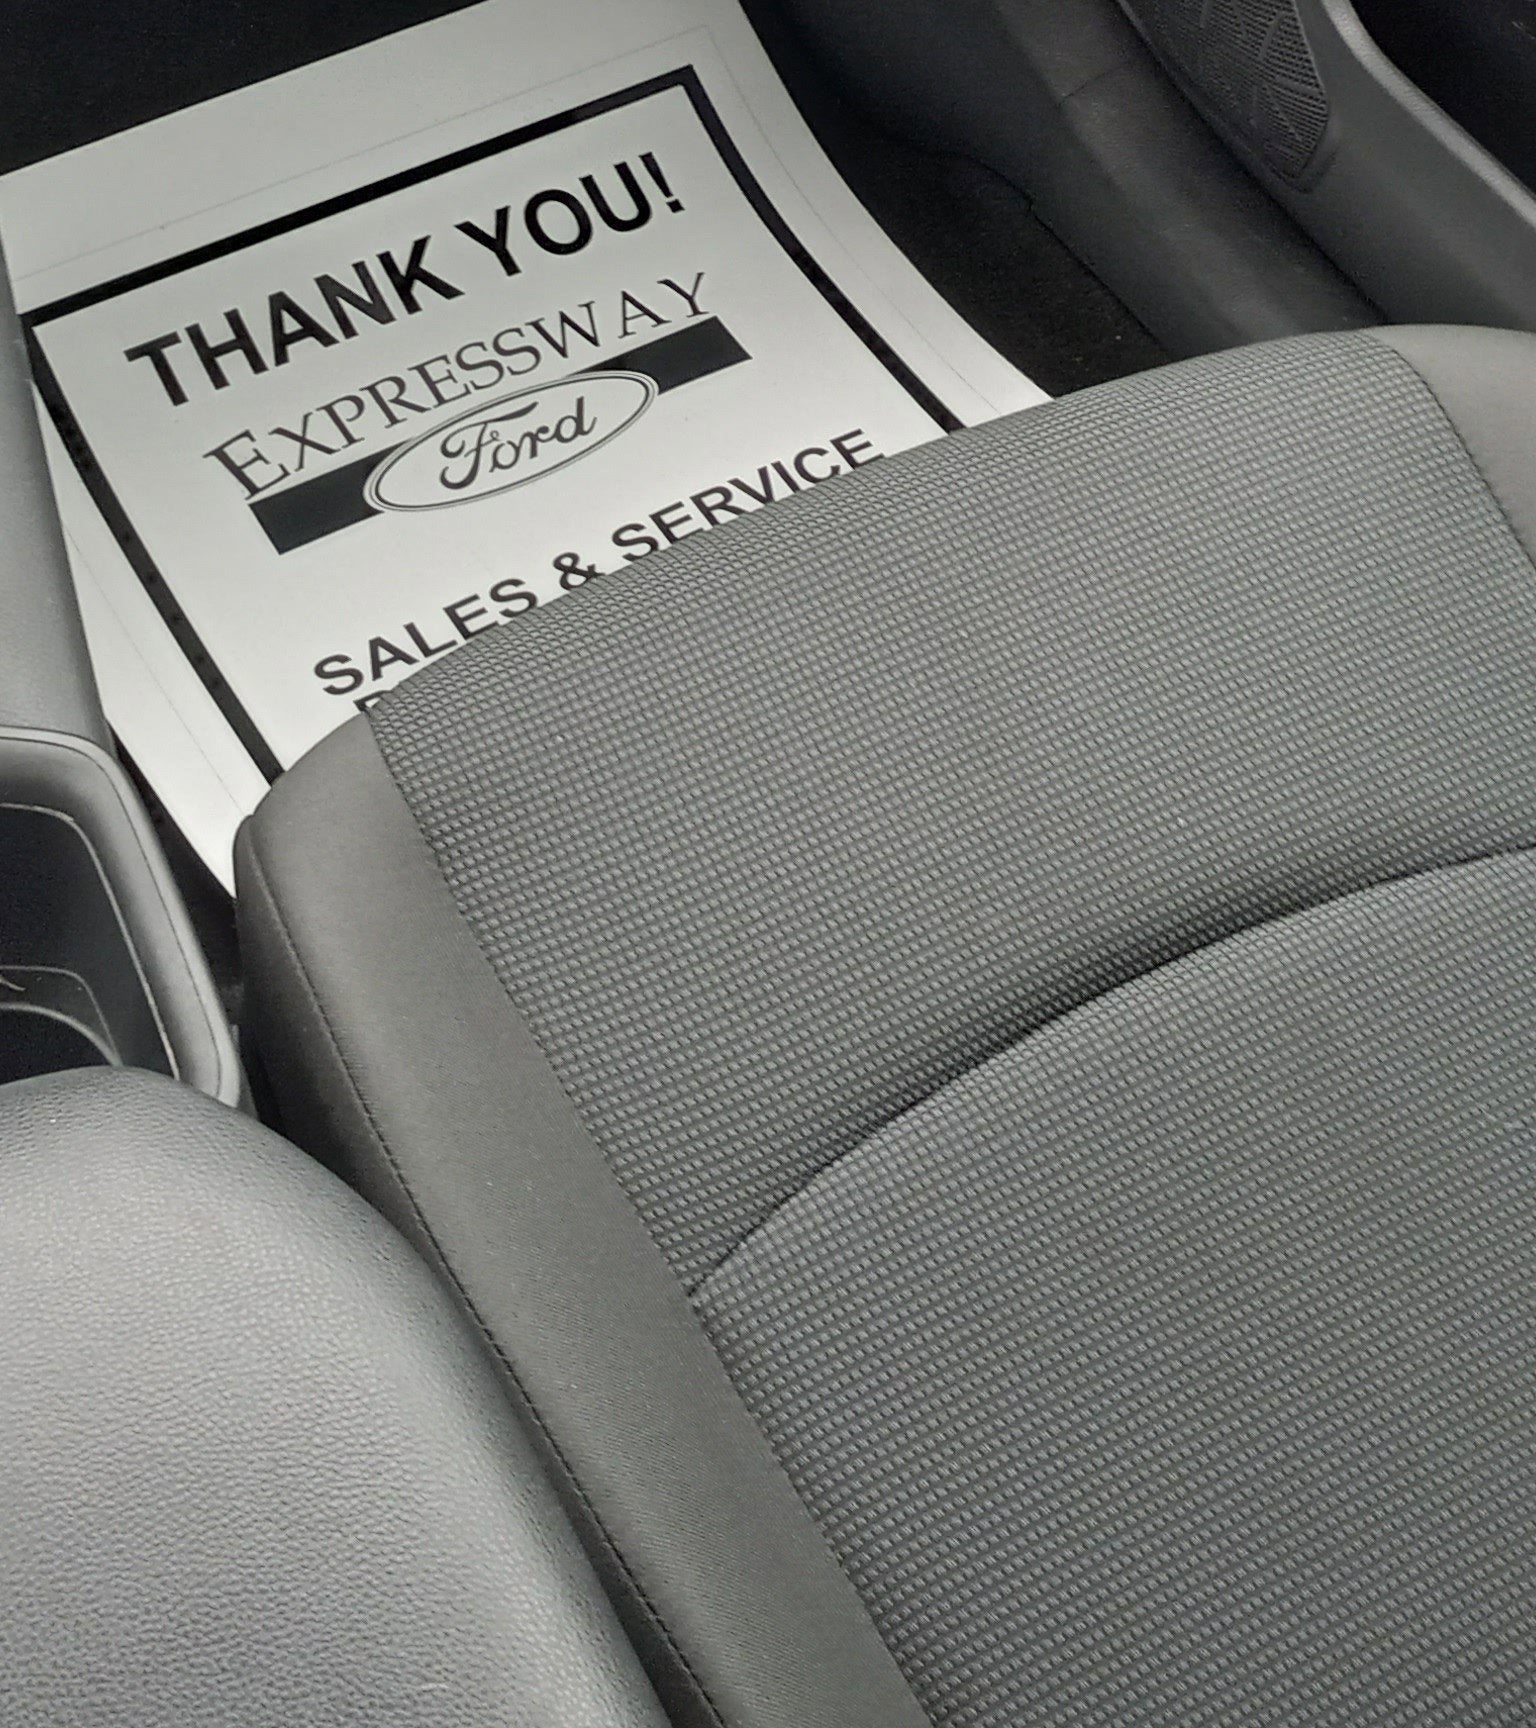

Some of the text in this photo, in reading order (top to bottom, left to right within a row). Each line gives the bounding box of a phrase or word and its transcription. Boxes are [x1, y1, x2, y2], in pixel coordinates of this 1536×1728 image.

[123, 151, 685, 407] THANK YOU!
[202, 272, 711, 500] EXPRESSWAY
[314, 428, 885, 695] SALES & SERVICE
[438, 396, 598, 491] Ford
